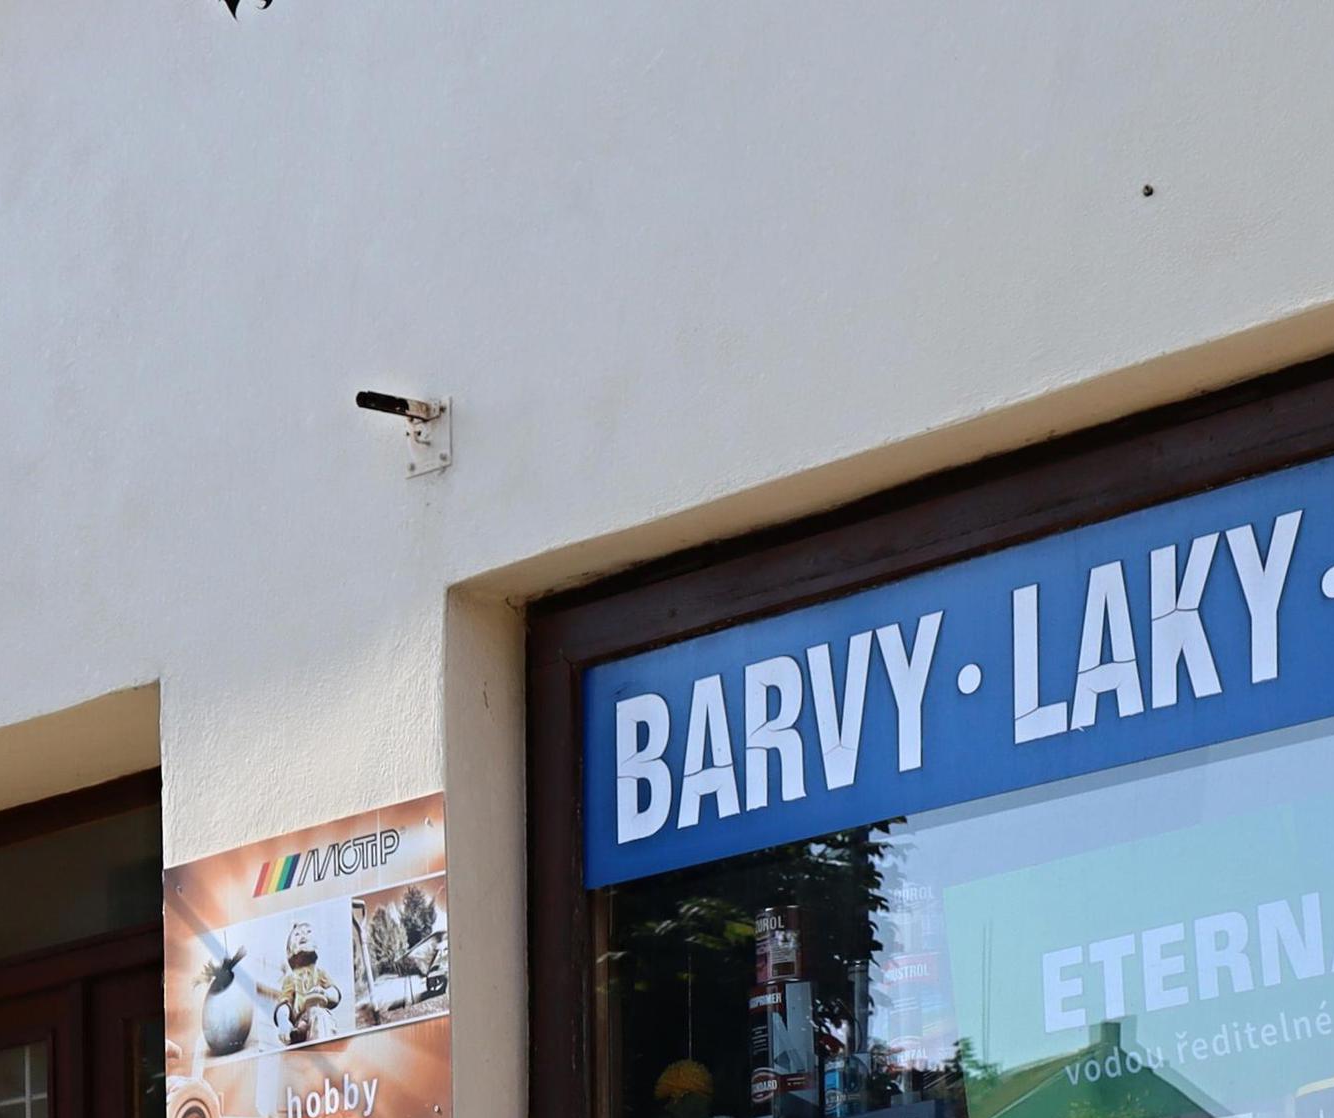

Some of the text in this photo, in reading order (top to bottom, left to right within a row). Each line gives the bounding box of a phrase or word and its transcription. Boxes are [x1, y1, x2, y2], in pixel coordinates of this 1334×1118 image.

[616, 610, 944, 844] BARVY
[1012, 509, 1304, 744] LAKY
[1065, 1044, 1164, 1086] vodou
[1178, 1001, 1333, 1066] ředitelné
